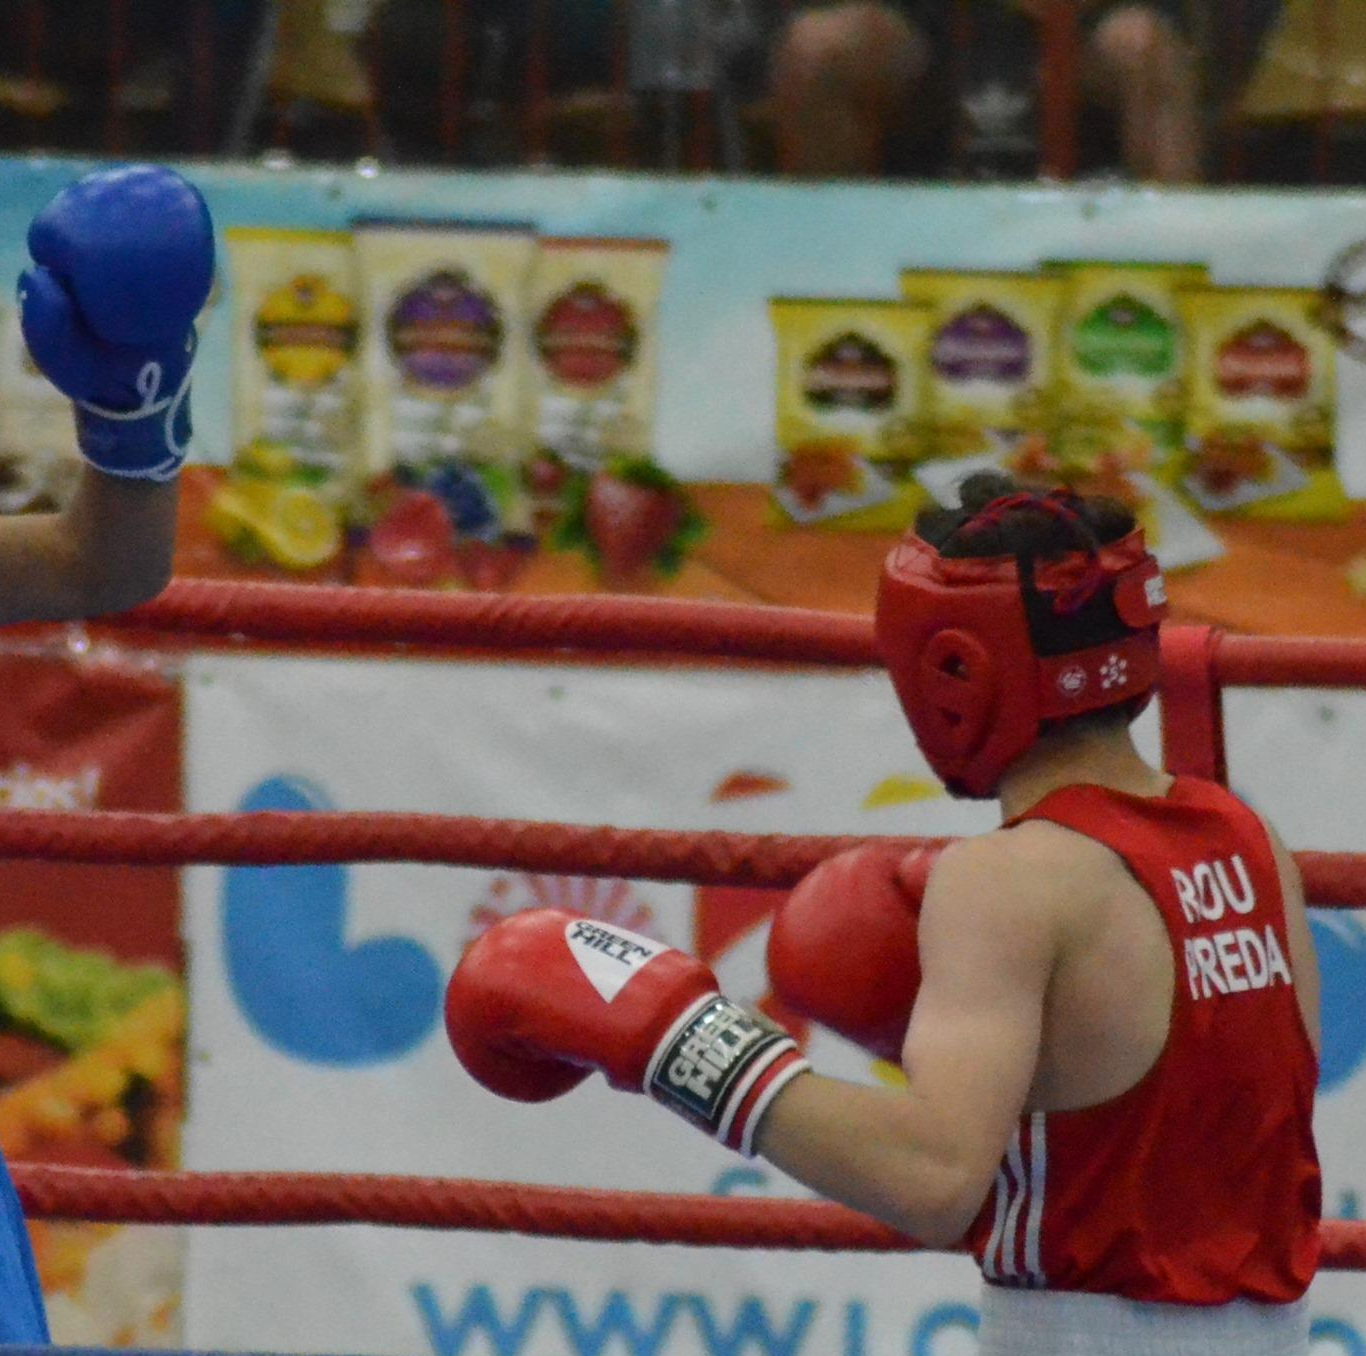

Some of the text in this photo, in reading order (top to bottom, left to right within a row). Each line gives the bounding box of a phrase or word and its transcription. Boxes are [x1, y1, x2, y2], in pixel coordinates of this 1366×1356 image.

[1170, 853, 1256, 924] ROU
[569, 929, 632, 966] HILL
[576, 921, 654, 958] GREEN
[1184, 923, 1293, 1001] PREDA
[686, 1021, 764, 1100] HILL
